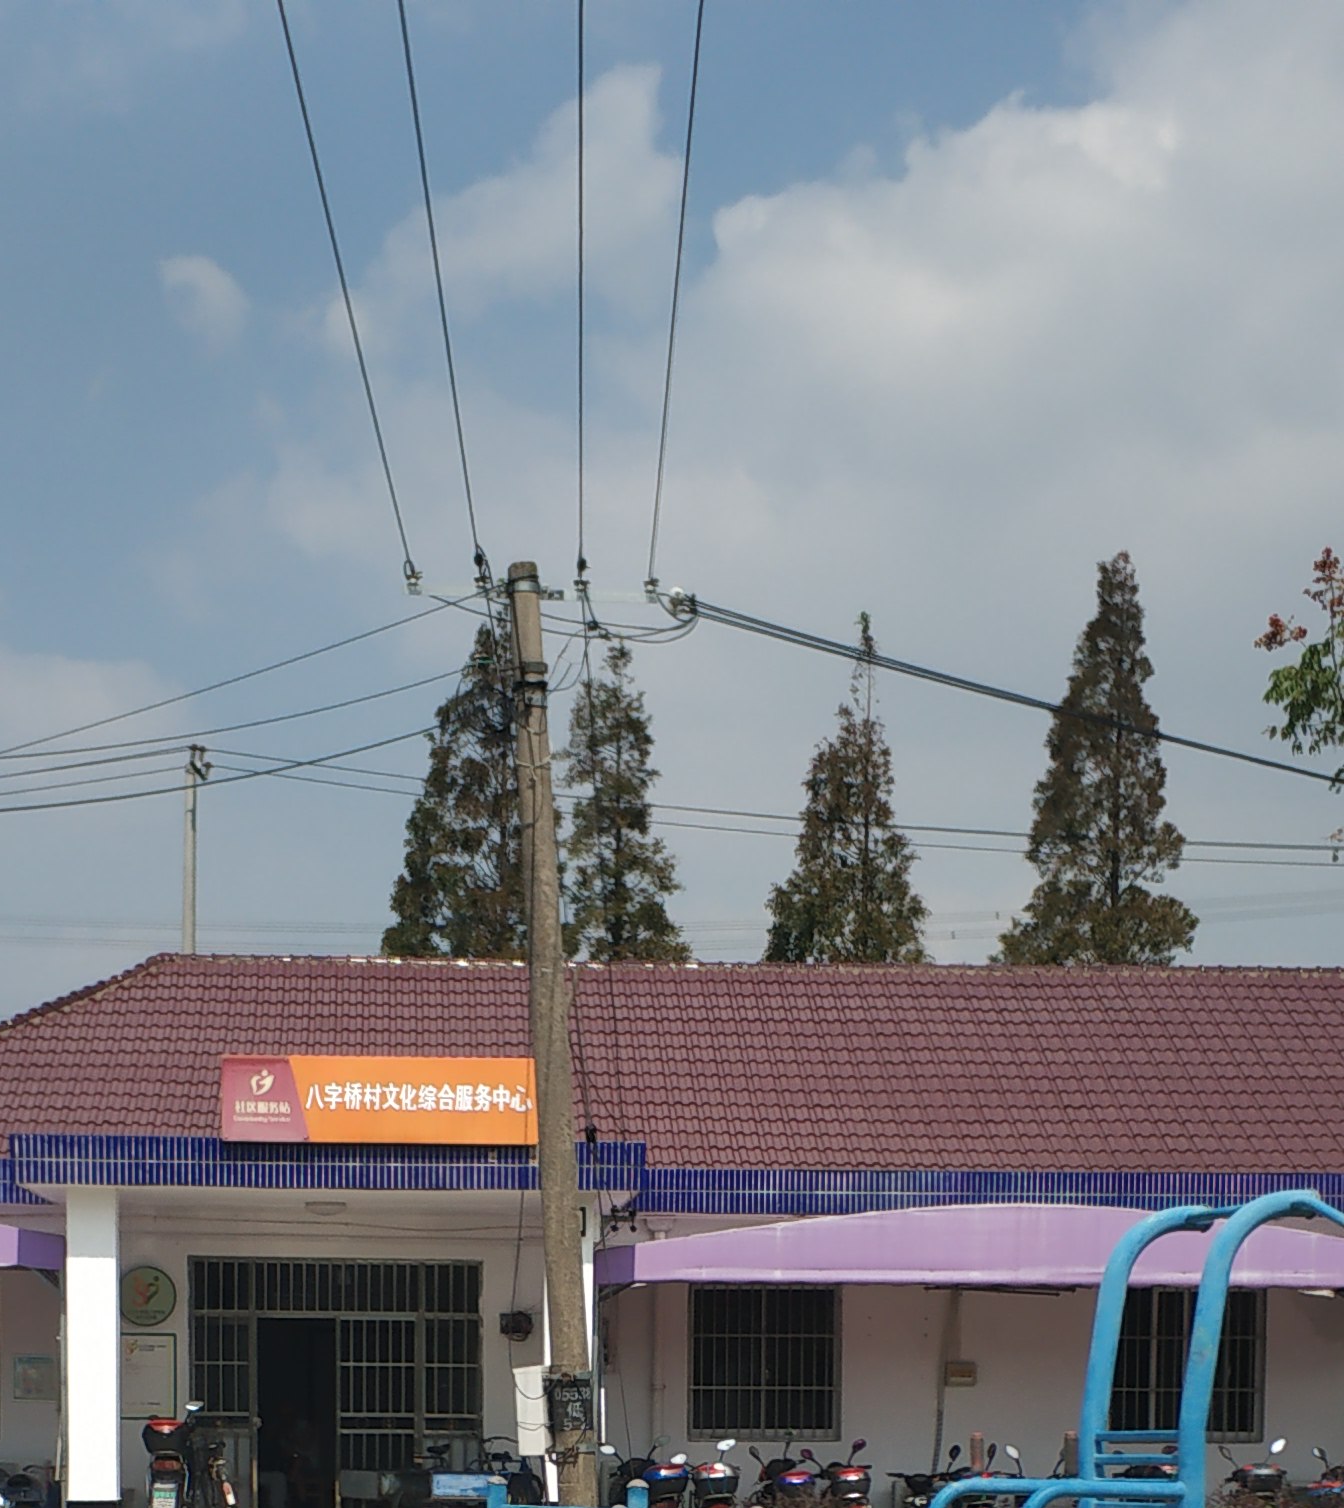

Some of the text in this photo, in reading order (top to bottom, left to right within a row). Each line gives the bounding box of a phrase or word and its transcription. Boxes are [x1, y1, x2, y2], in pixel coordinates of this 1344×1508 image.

[305, 1081, 533, 1112] 八字桥村文化综合服务中心
